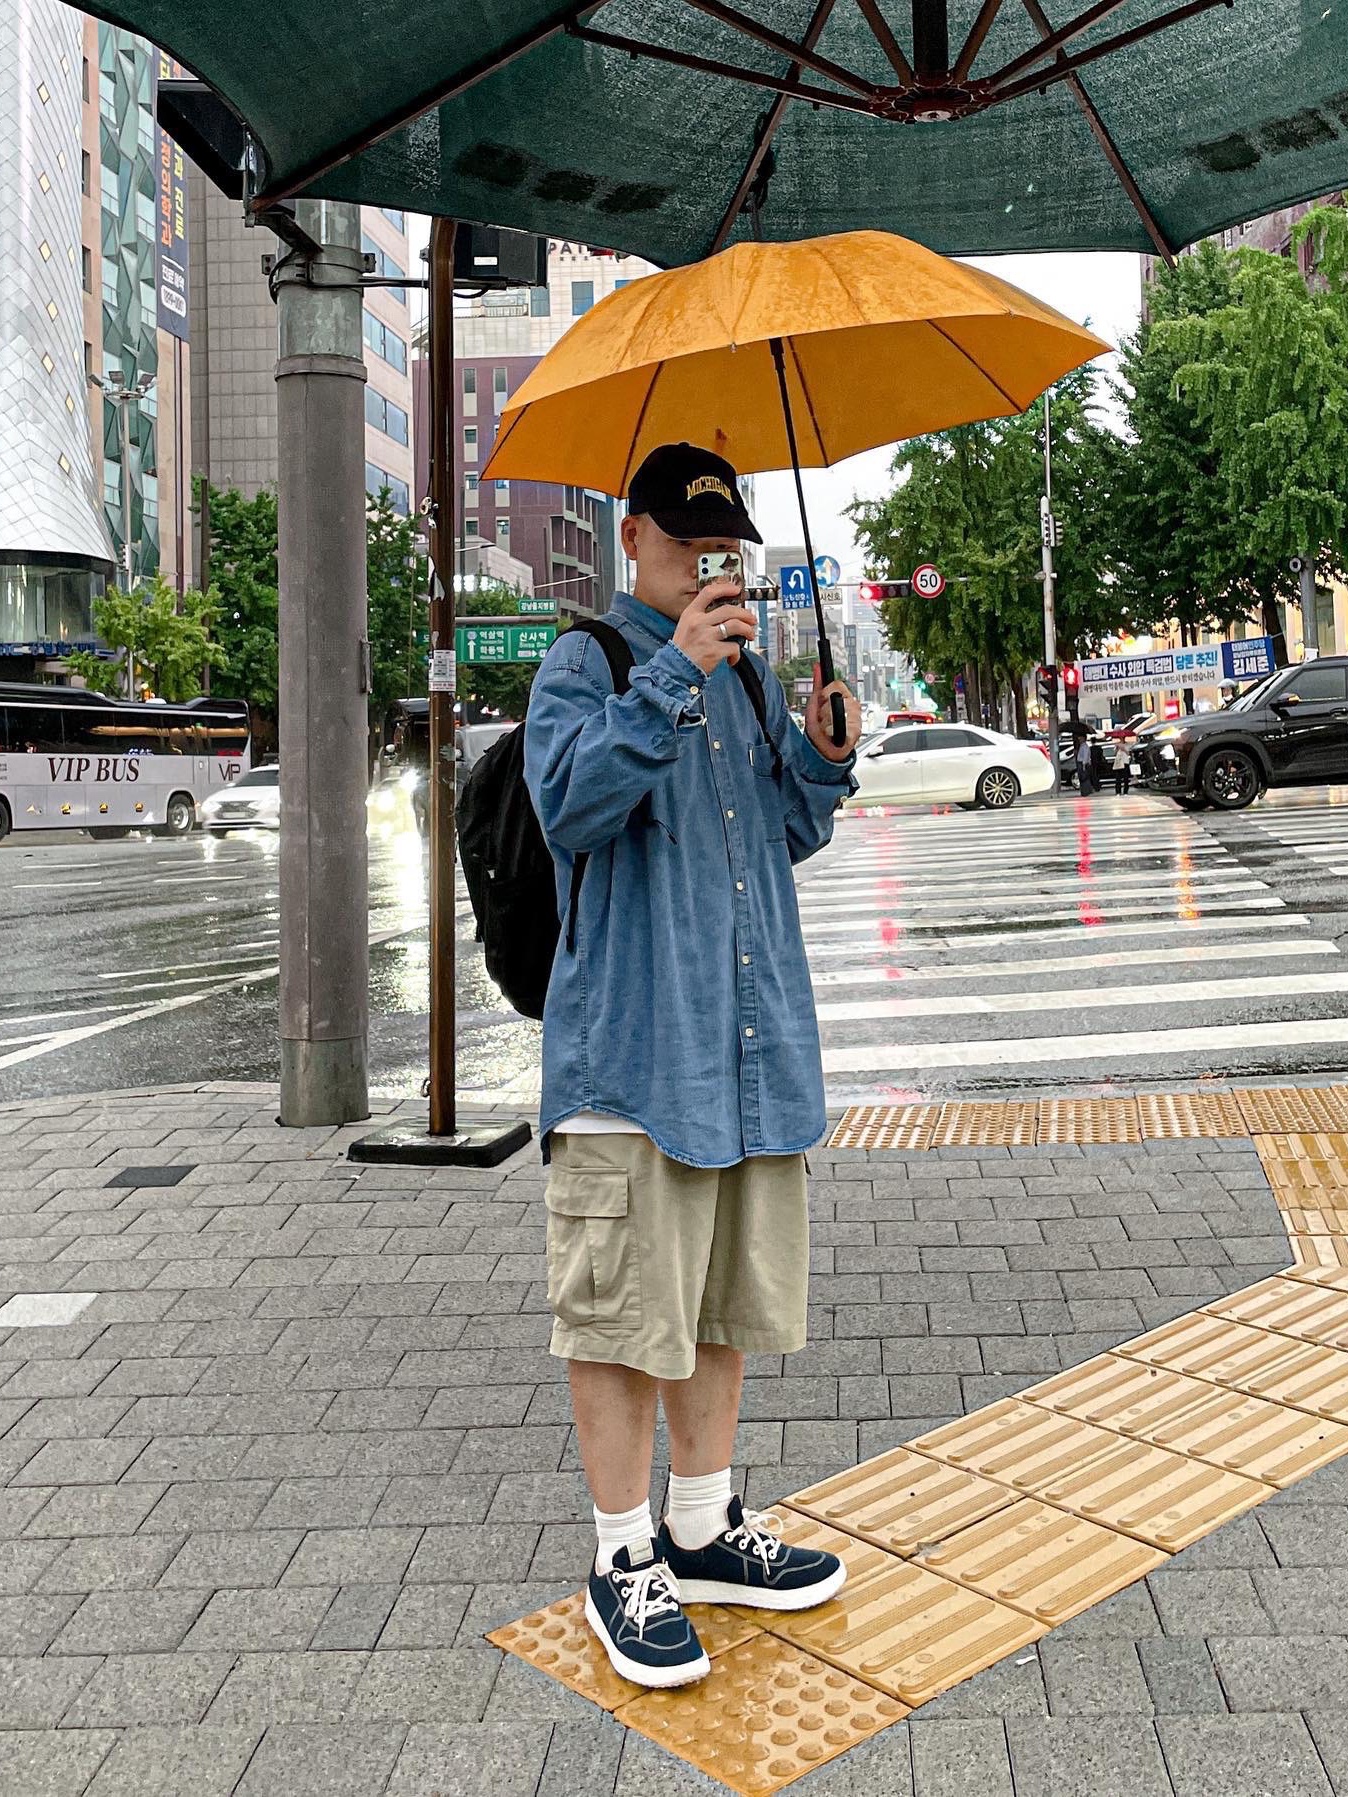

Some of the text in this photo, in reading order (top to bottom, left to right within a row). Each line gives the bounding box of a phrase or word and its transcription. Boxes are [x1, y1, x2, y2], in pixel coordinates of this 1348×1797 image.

[686, 476, 734, 505] MICHIGAN
[920, 573, 938, 588] 50
[820, 592, 841, 601] 시신호
[479, 630, 504, 640] 역삼역
[519, 631, 547, 642] 신사역
[1109, 662, 1127, 679] 수사
[1127, 659, 1145, 677] 외압
[1146, 656, 1172, 674] 특검법
[1176, 653, 1195, 671] 당론
[1196, 650, 1218, 668] 추진!
[1232, 655, 1270, 676] 김세준
[1140, 677, 1152, 688] 수사
[47, 757, 140, 782] VIP BUS
